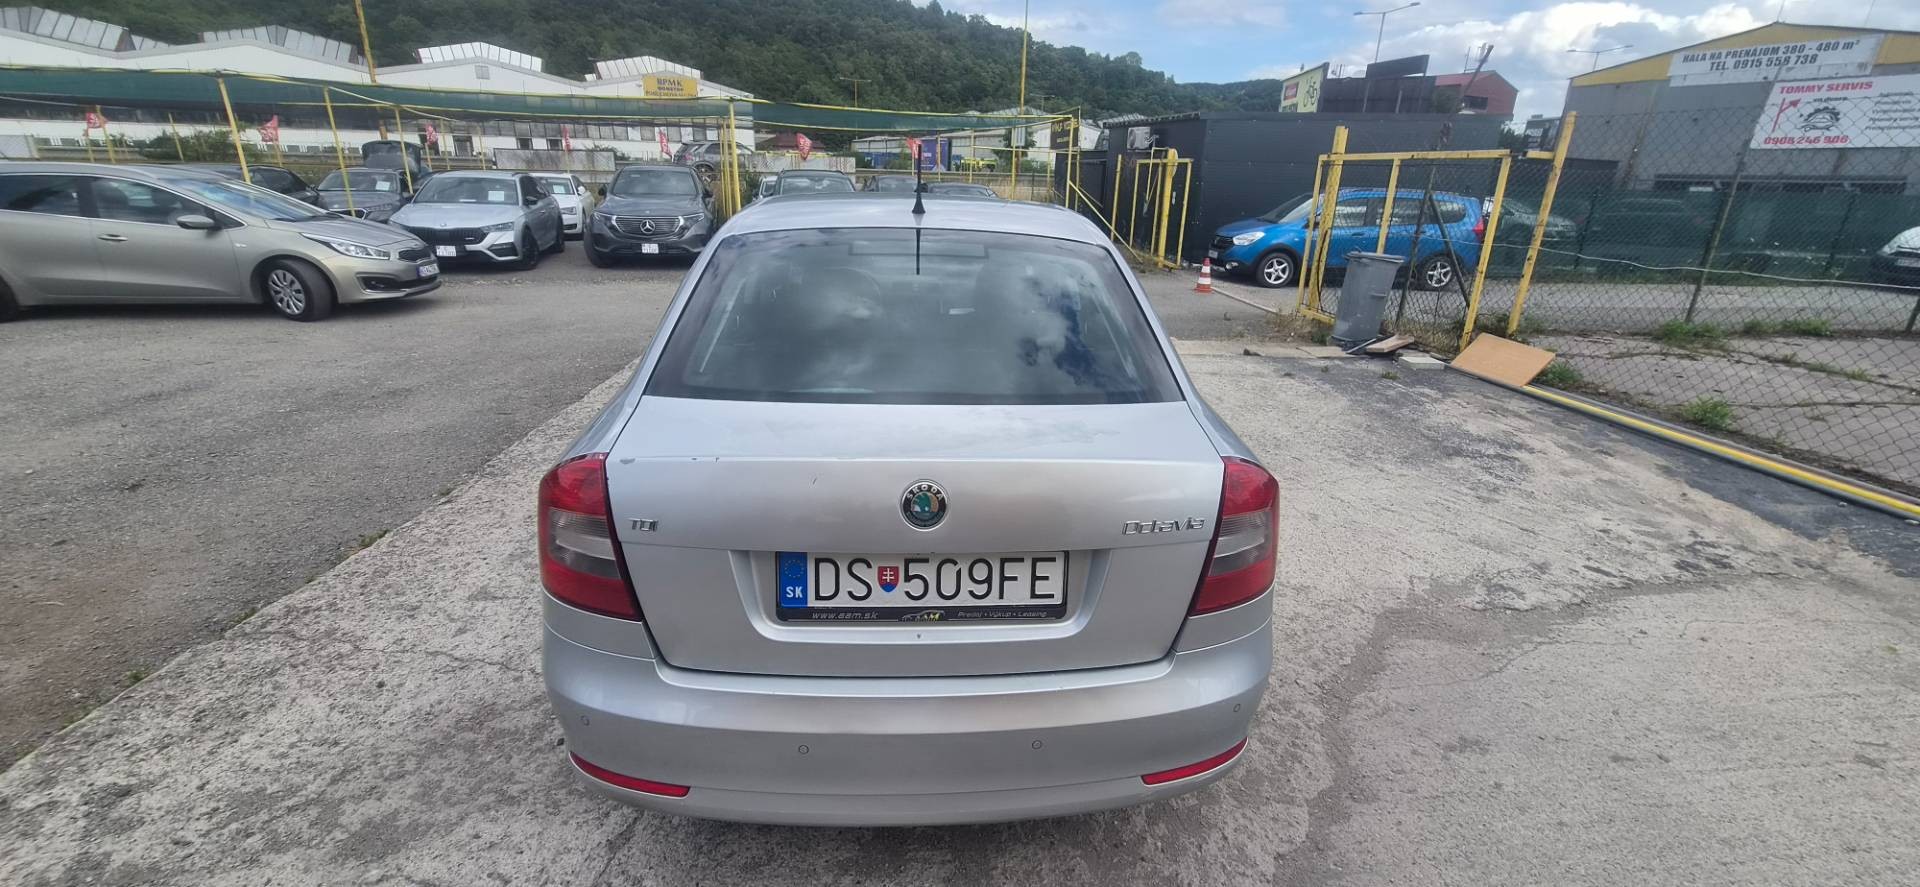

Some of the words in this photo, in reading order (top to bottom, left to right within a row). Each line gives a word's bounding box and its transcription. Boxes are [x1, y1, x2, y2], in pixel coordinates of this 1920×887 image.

[1682, 53, 1707, 63] HALA
[1708, 52, 1723, 62] NA
[1782, 44, 1805, 55] 380
[1815, 41, 1840, 53] 480
[1709, 61, 1730, 72] TEL.
[1733, 58, 1763, 70] 0915
[1765, 56, 1790, 67] 558
[1794, 53, 1819, 65] 738
[1780, 84, 1825, 94] TOMMY
[1826, 81, 1874, 92] SERVIS
[1796, 135, 1821, 144] 246
[1122, 517, 1205, 535] Octavia
[785, 587, 803, 598] SK
